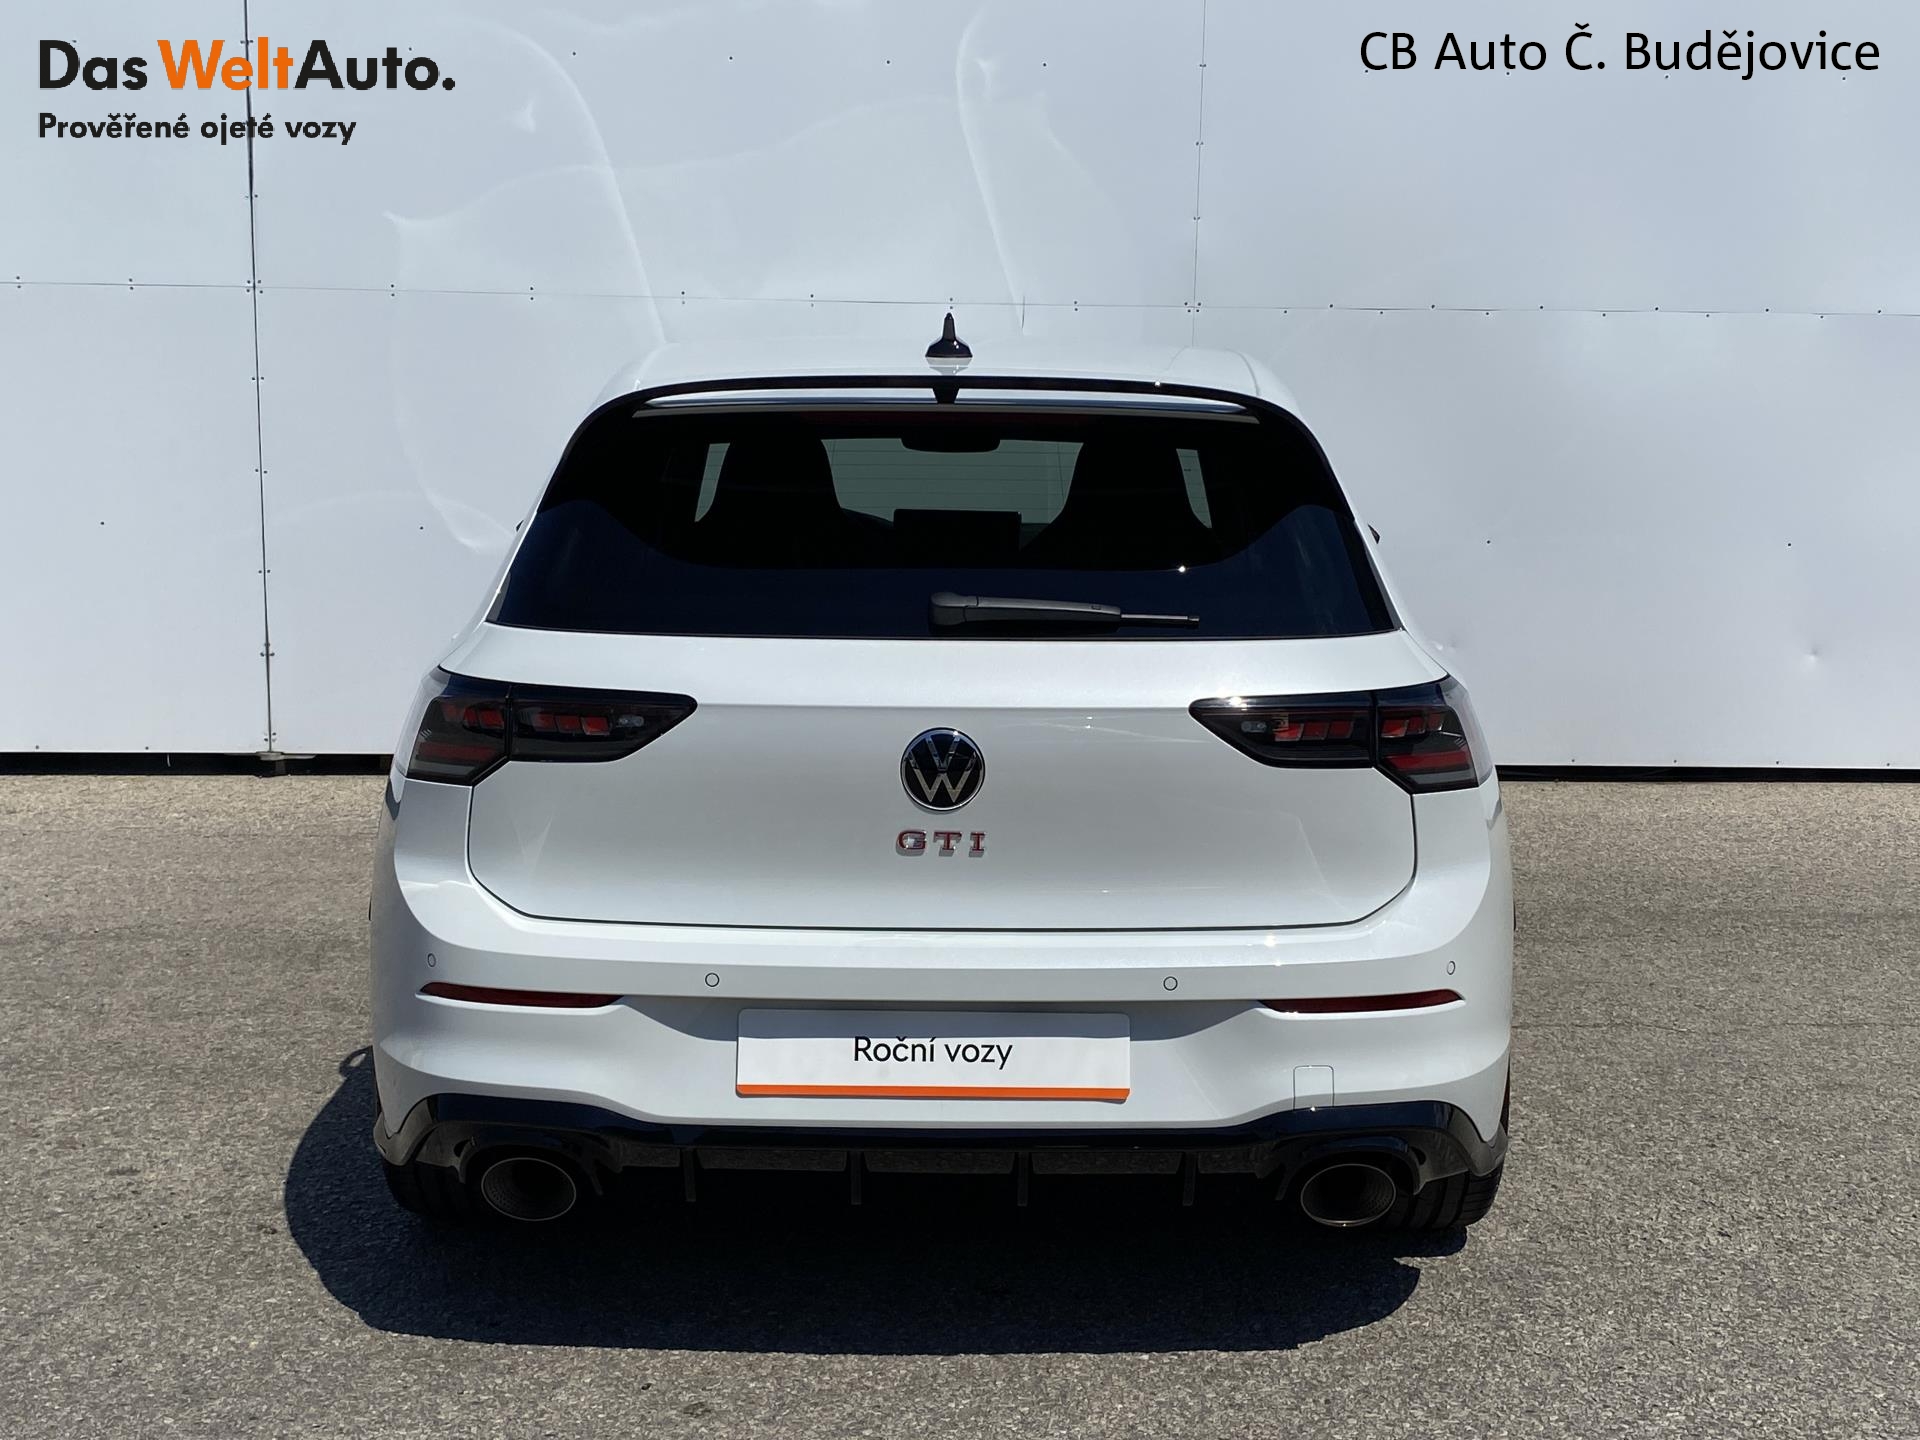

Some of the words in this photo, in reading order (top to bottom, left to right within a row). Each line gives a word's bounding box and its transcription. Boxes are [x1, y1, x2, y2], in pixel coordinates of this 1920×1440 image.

[902, 729, 984, 809] VW
[897, 830, 986, 856] GTI
[854, 1036, 934, 1062] Roční
[944, 1041, 1013, 1070] vozy
